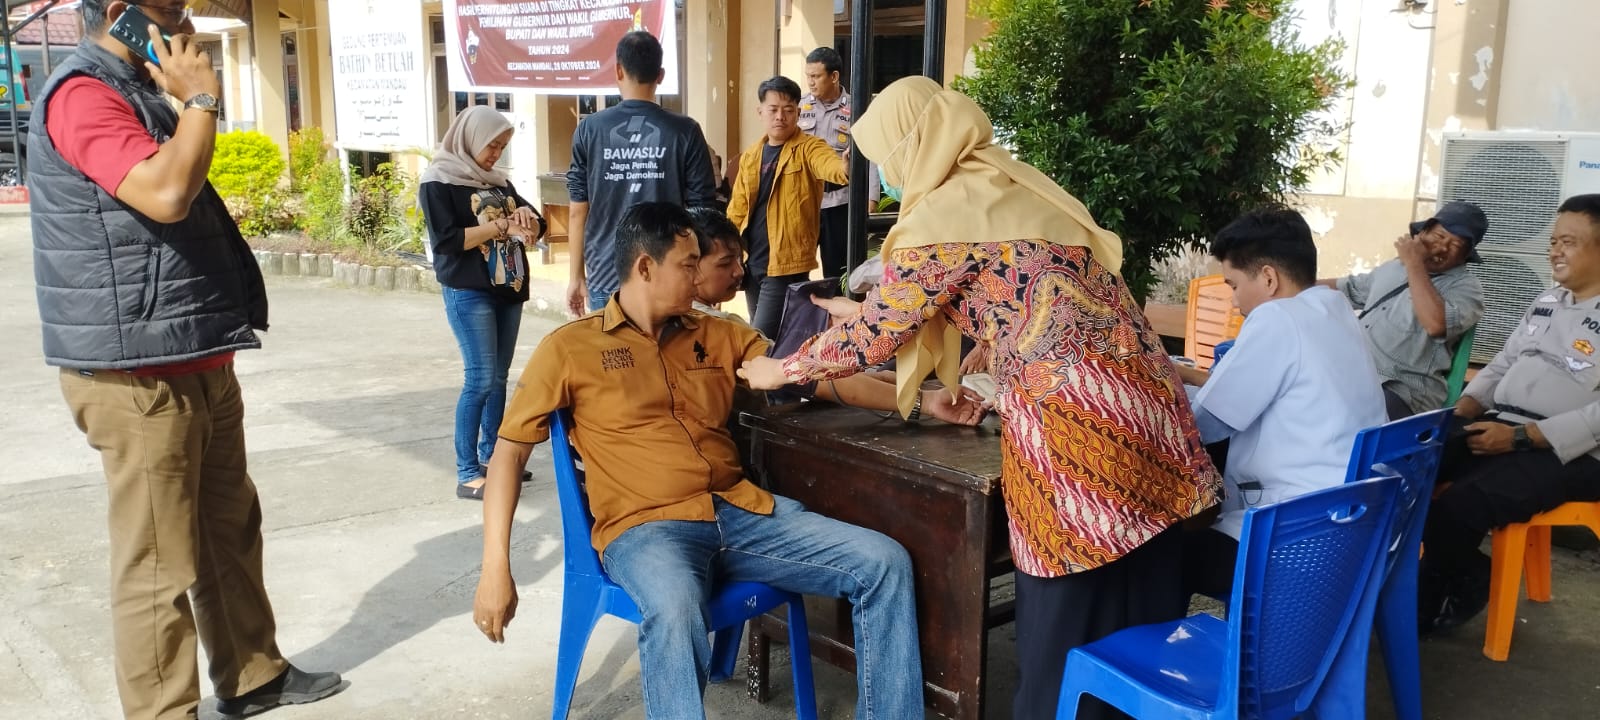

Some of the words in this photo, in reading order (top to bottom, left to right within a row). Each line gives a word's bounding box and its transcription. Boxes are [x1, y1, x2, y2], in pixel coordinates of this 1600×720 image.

[519, 2, 541, 14] SUARA
[541, 1, 549, 12] DI
[549, 0, 579, 12] TINGKAT
[512, 14, 550, 28] GUBERNUR
[551, 13, 566, 25] DAN
[566, 11, 588, 24] WAKIL
[590, 7, 634, 22] GUBERNUR,
[506, 28, 530, 40] BUPATI
[531, 27, 547, 40] DAN
[548, 26, 569, 39] WAKIL
[528, 45, 550, 55] TAHUN
[551, 44, 570, 55] 2024
[375, 51, 414, 73] BETUAH
[561, 61, 585, 71] OKTOBER
[586, 60, 600, 70] 2024
[603, 146, 666, 160] BAWASLU
[610, 161, 630, 171] Jaga
[604, 172, 624, 182] Jaga
[626, 171, 665, 180] Demokrasi
[601, 346, 632, 359] THINK
[602, 354, 635, 365] DECIDE
[603, 360, 635, 372] FIGHT
